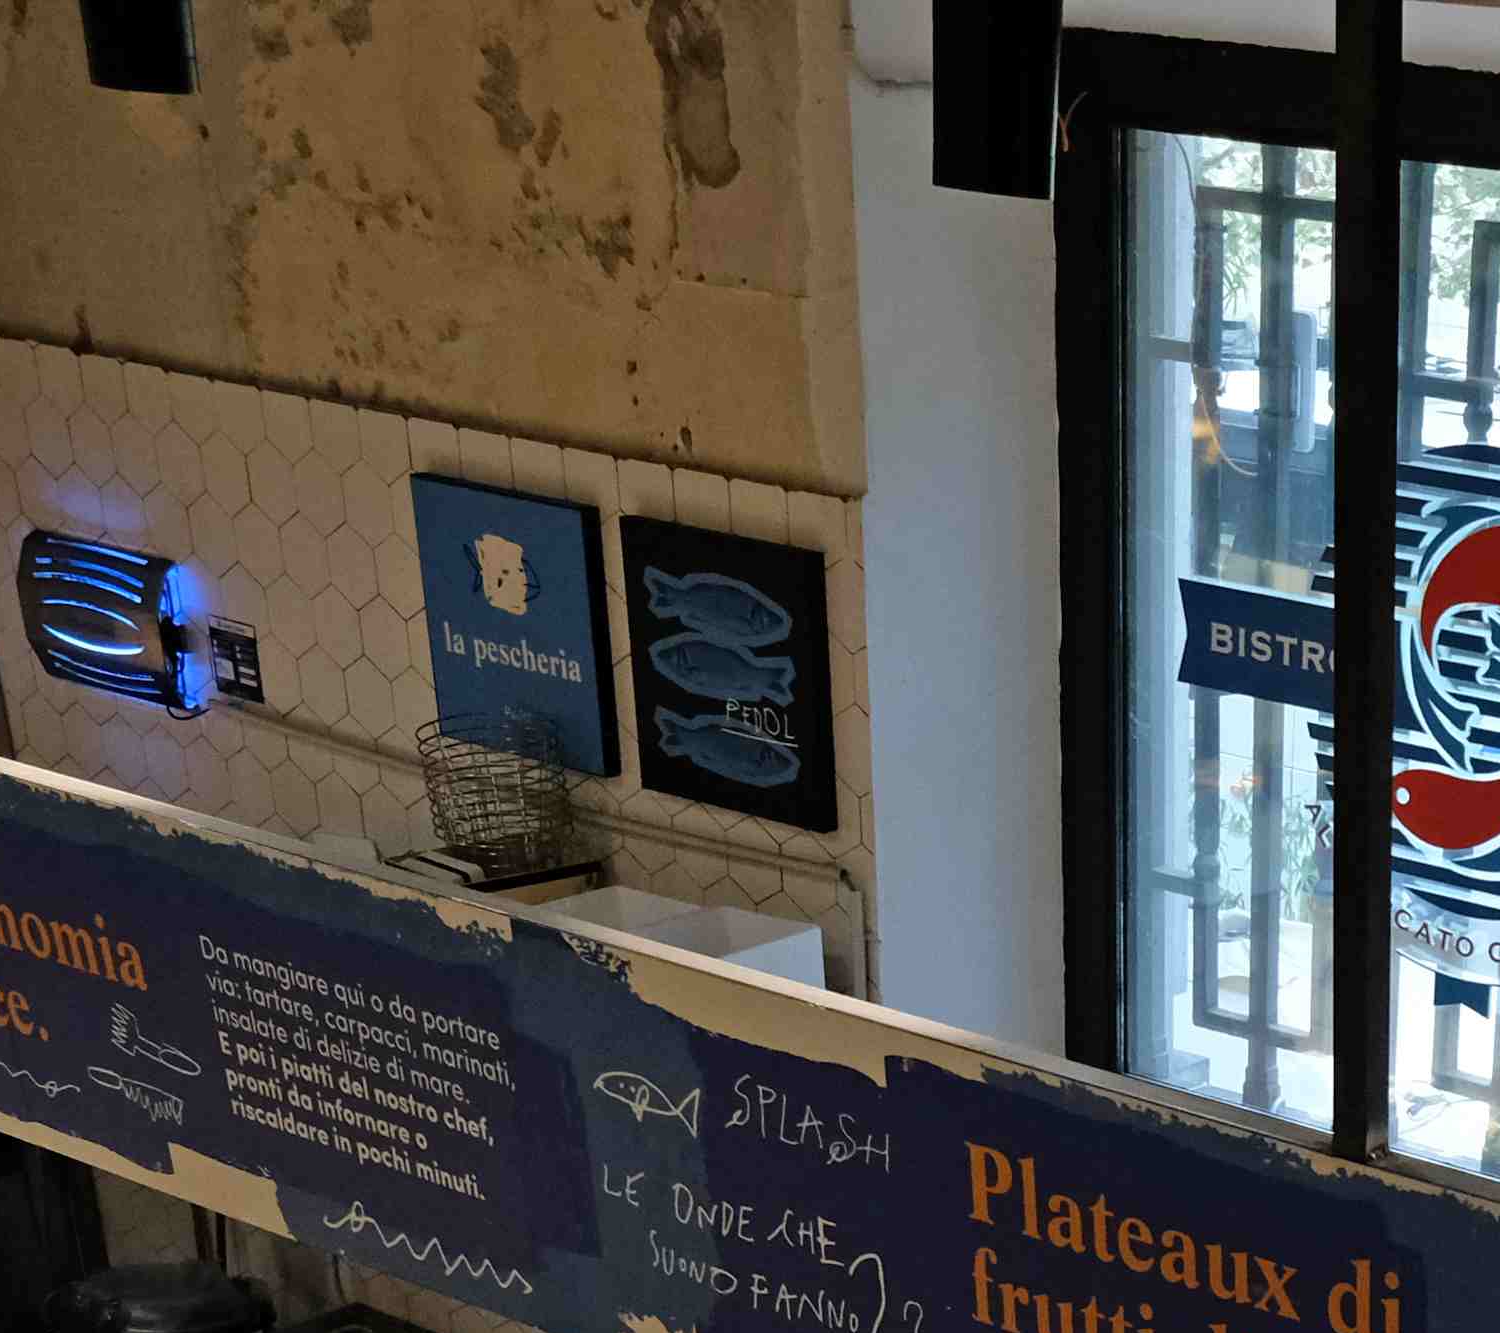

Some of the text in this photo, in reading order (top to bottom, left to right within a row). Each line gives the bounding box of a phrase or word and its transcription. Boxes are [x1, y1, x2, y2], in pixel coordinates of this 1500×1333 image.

[444, 620, 583, 683] la pescheria
[1210, 621, 1335, 674] BISTR
[724, 697, 797, 740] PEDOL
[1393, 909, 1475, 957] CATO
[199, 934, 502, 1051] Da mangiare qui o da portare
[206, 972, 517, 1094] via: tartare, carpacci, marinati,
[212, 999, 472, 1106] insalate di delizie di mare.
[218, 1030, 495, 1148] E poi i piatti del nostro chef,
[224, 1066, 429, 1151] pronti da infornare o
[230, 1095, 487, 1202] riscaldare in pochi minuti.
[723, 1073, 892, 1174] SPLASH
[603, 1164, 845, 1267] LE ONDE CHE
[964, 1139, 1302, 1323] Plateaux
[649, 1229, 739, 1294] SUONO
[749, 1273, 860, 1333] FANNO
